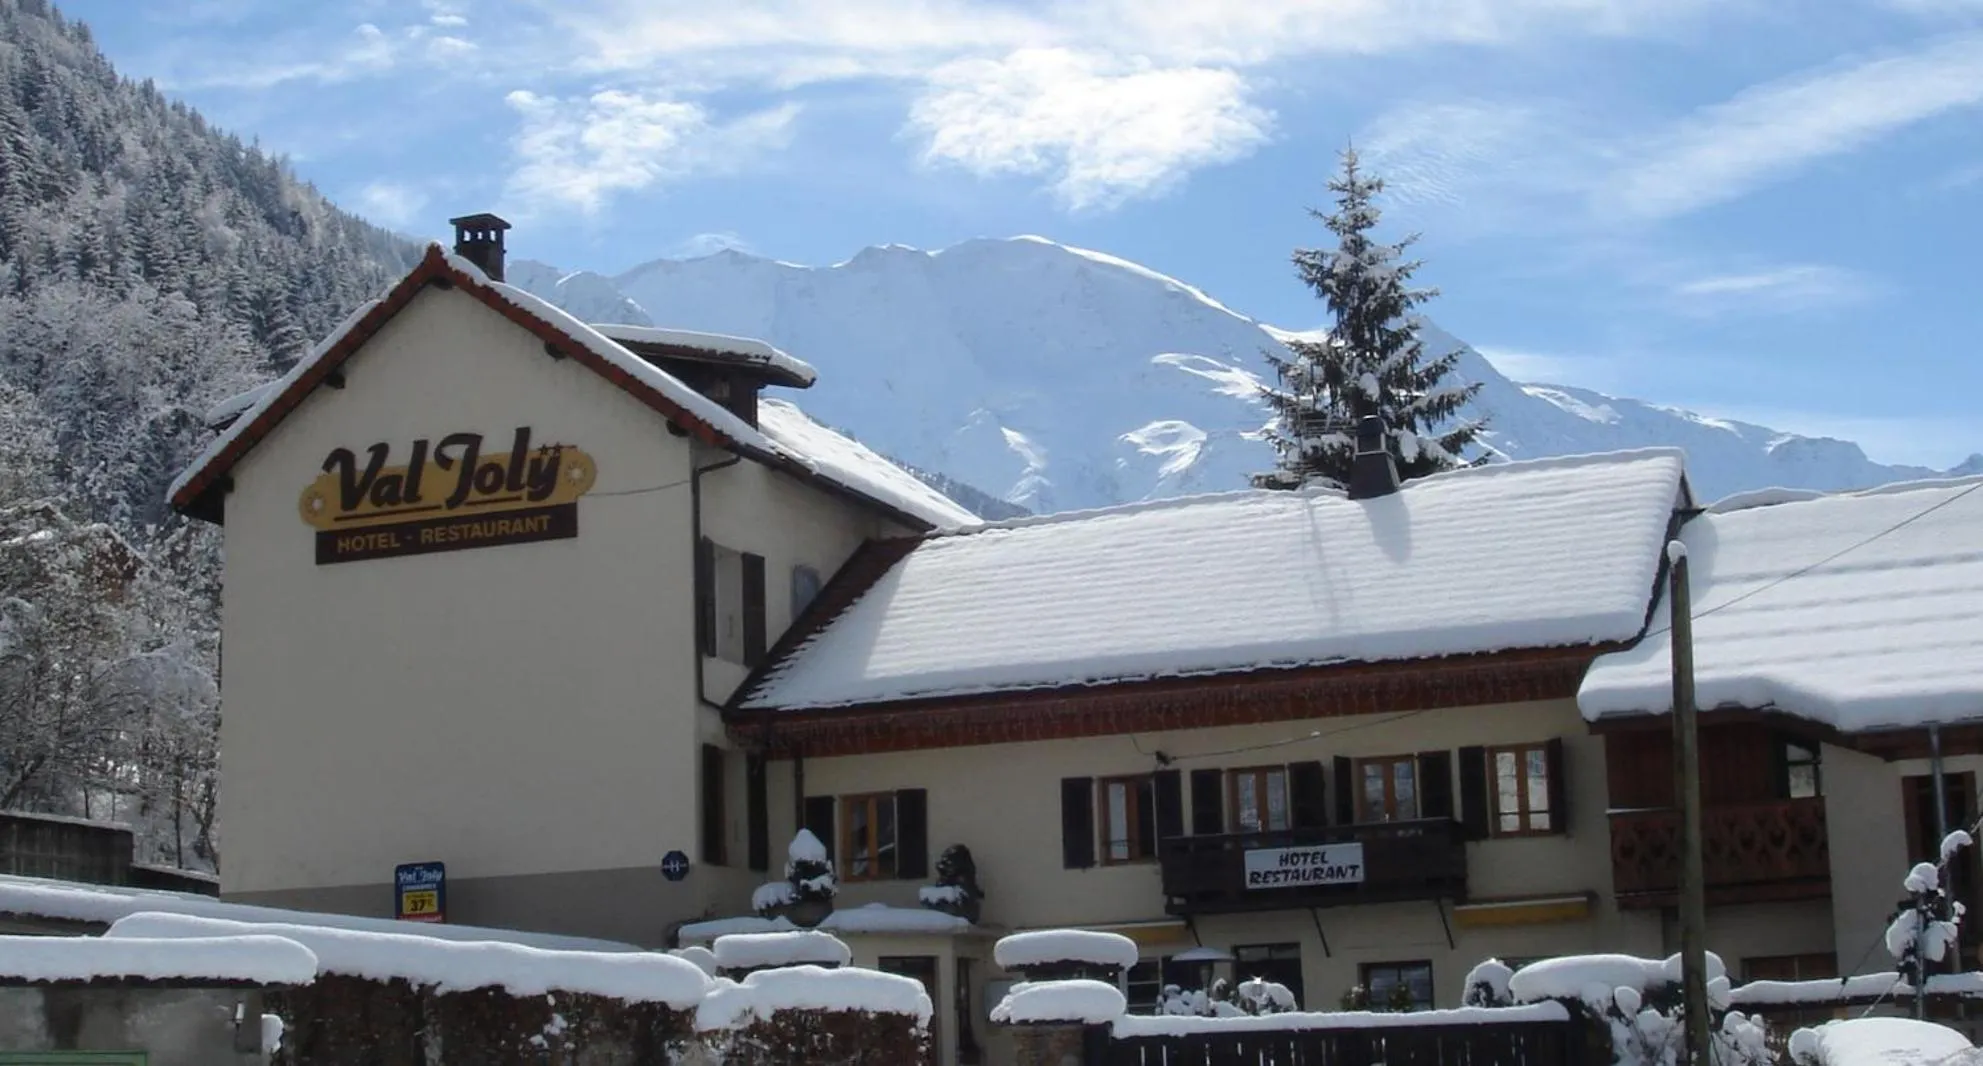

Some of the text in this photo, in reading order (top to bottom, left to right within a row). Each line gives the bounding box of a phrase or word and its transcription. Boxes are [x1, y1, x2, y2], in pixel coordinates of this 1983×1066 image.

[322, 426, 561, 512] Val Joly
[337, 532, 401, 554] HOTEL
[420, 514, 551, 545] RESTAURANT
[1249, 851, 1360, 885] HOTEL RESTAURANT
